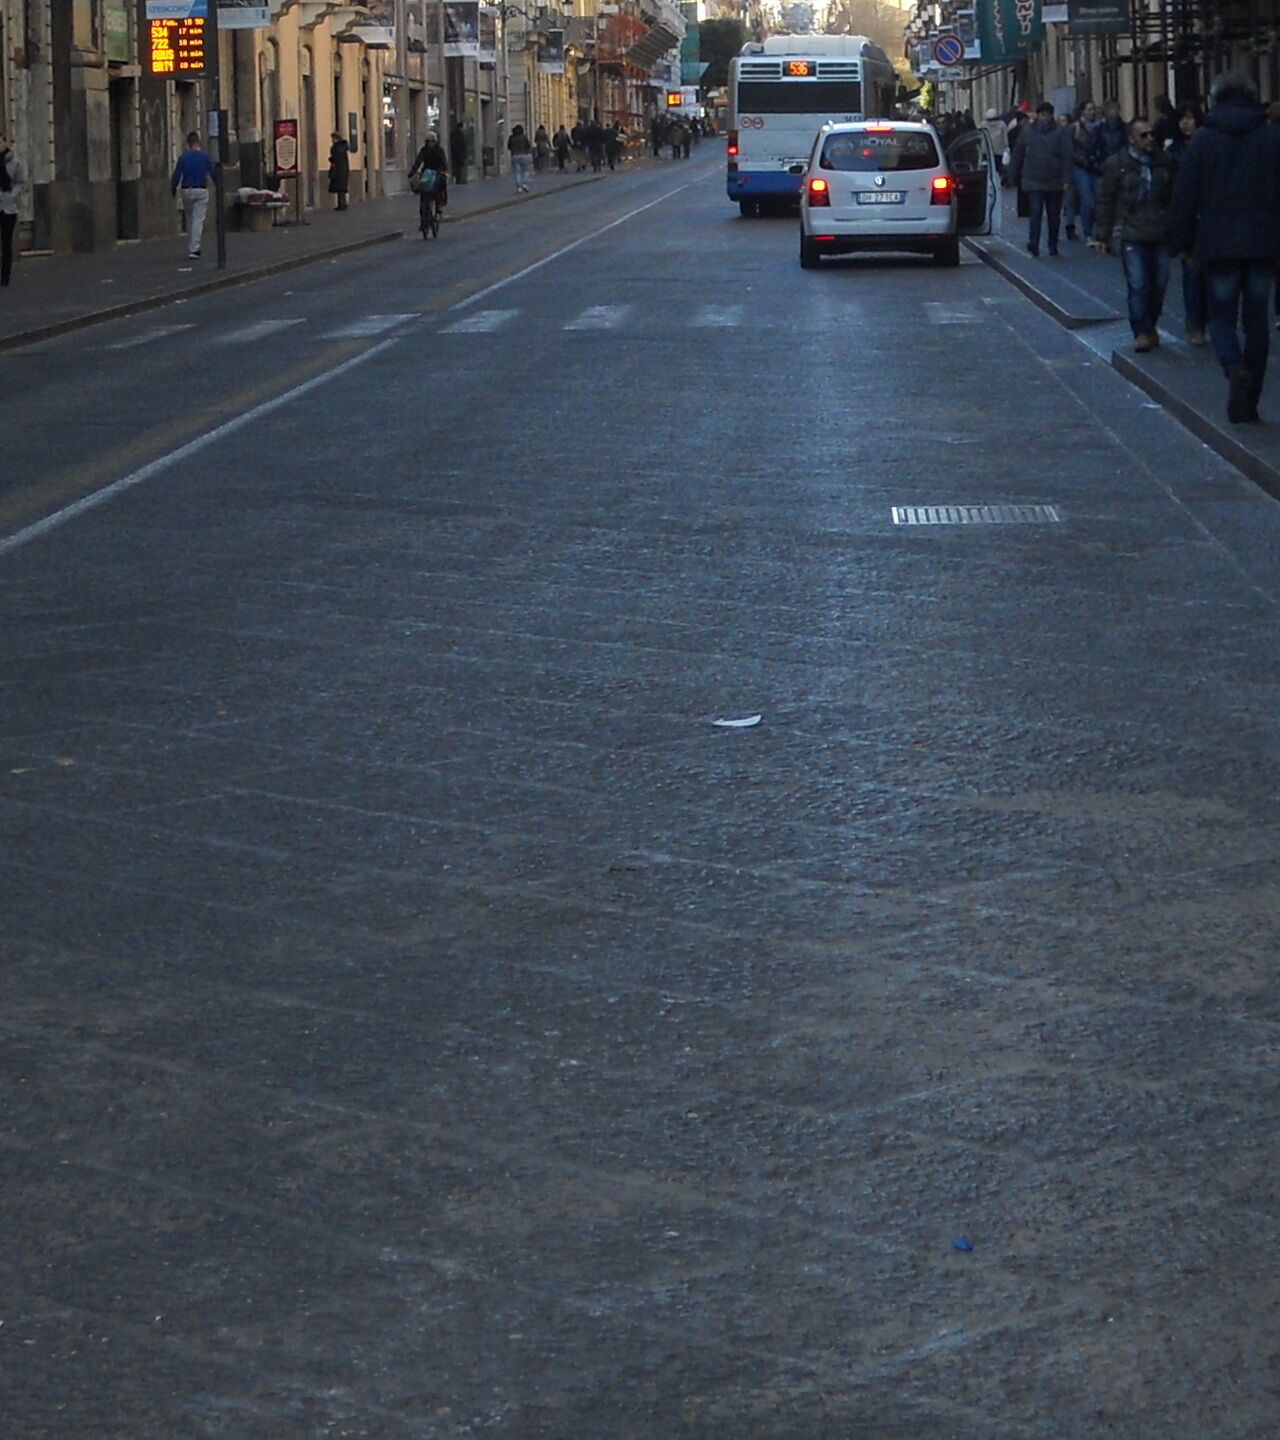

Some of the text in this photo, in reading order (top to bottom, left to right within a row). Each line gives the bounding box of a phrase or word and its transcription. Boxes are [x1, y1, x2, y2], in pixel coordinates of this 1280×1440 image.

[151, 27, 168, 38] 534
[151, 38, 169, 50] 722
[789, 61, 808, 75] 536
